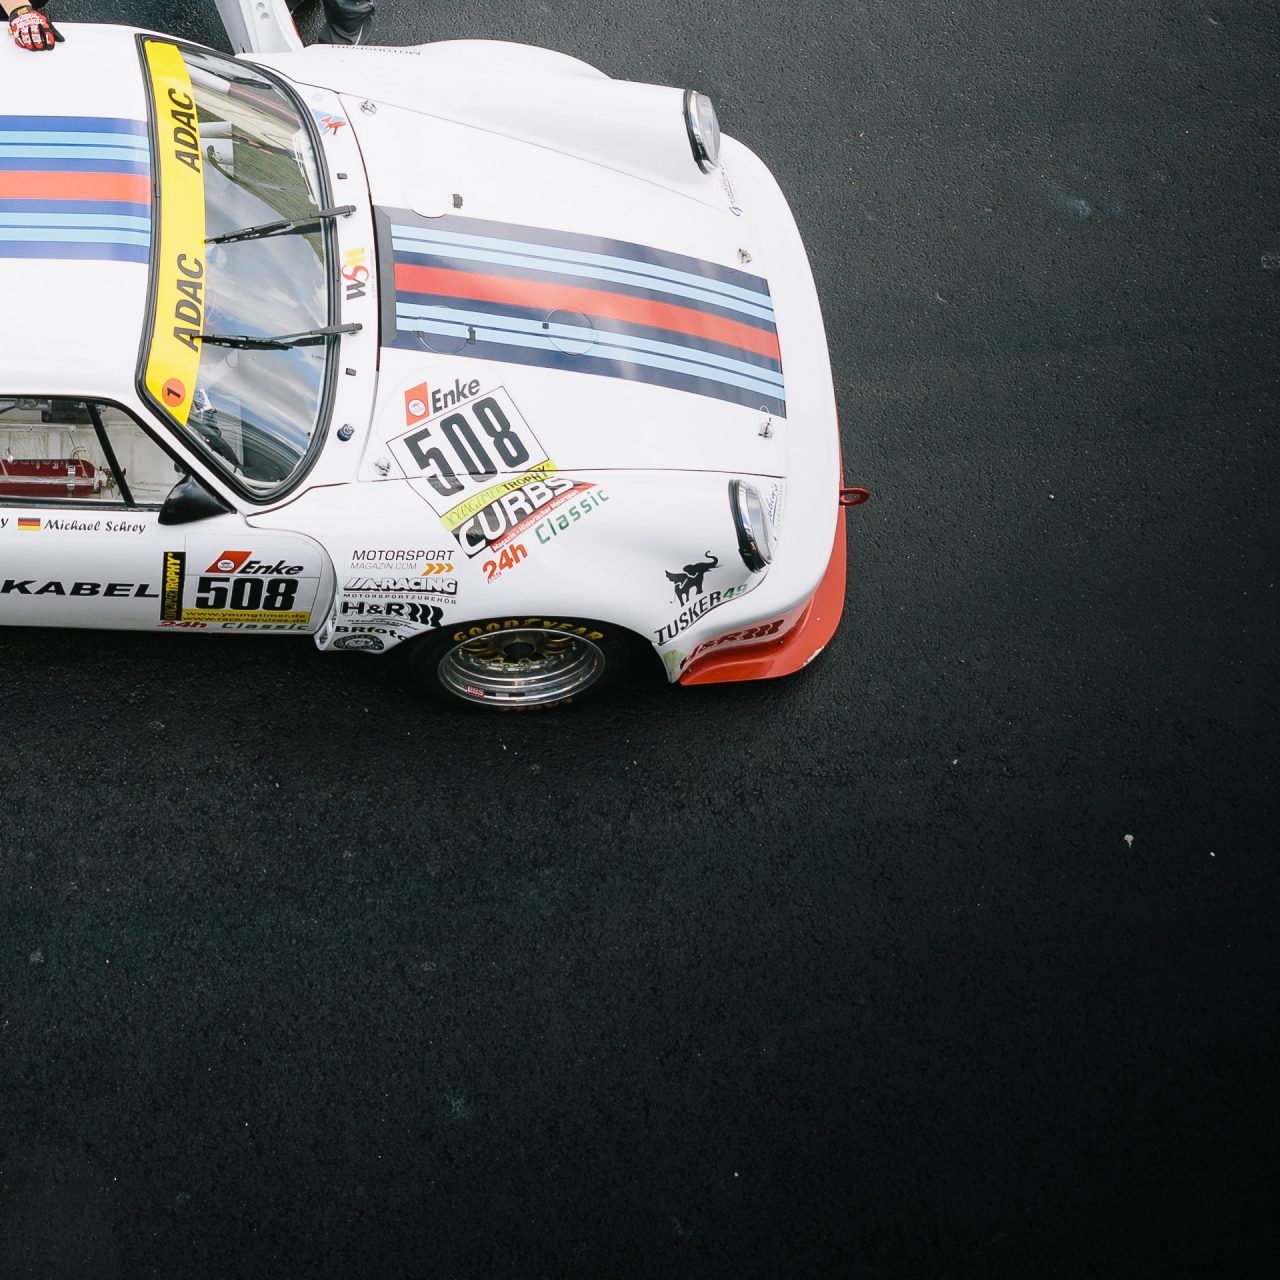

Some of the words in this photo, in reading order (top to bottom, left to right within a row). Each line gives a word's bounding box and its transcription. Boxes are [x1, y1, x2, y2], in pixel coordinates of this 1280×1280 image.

[167, 87, 201, 174] ADAC
[172, 253, 204, 353] ADAC
[166, 386, 181, 399] 1
[431, 378, 481, 414] Enke
[403, 396, 530, 497] 508
[458, 477, 575, 556] CURBS
[43, 519, 101, 533] Michael
[104, 520, 147, 535] Schrey
[482, 543, 528, 584] 24h
[534, 489, 610, 545] Classic
[352, 549, 455, 561] MOTORSPORT
[237, 559, 305, 576] Enke
[350, 562, 418, 570] MAGAZIN.COM
[0, 579, 161, 599] KABEL
[194, 576, 300, 611] 508
[340, 601, 413, 620] H&R
[158, 619, 208, 630] 24h
[220, 622, 310, 631] Classic
